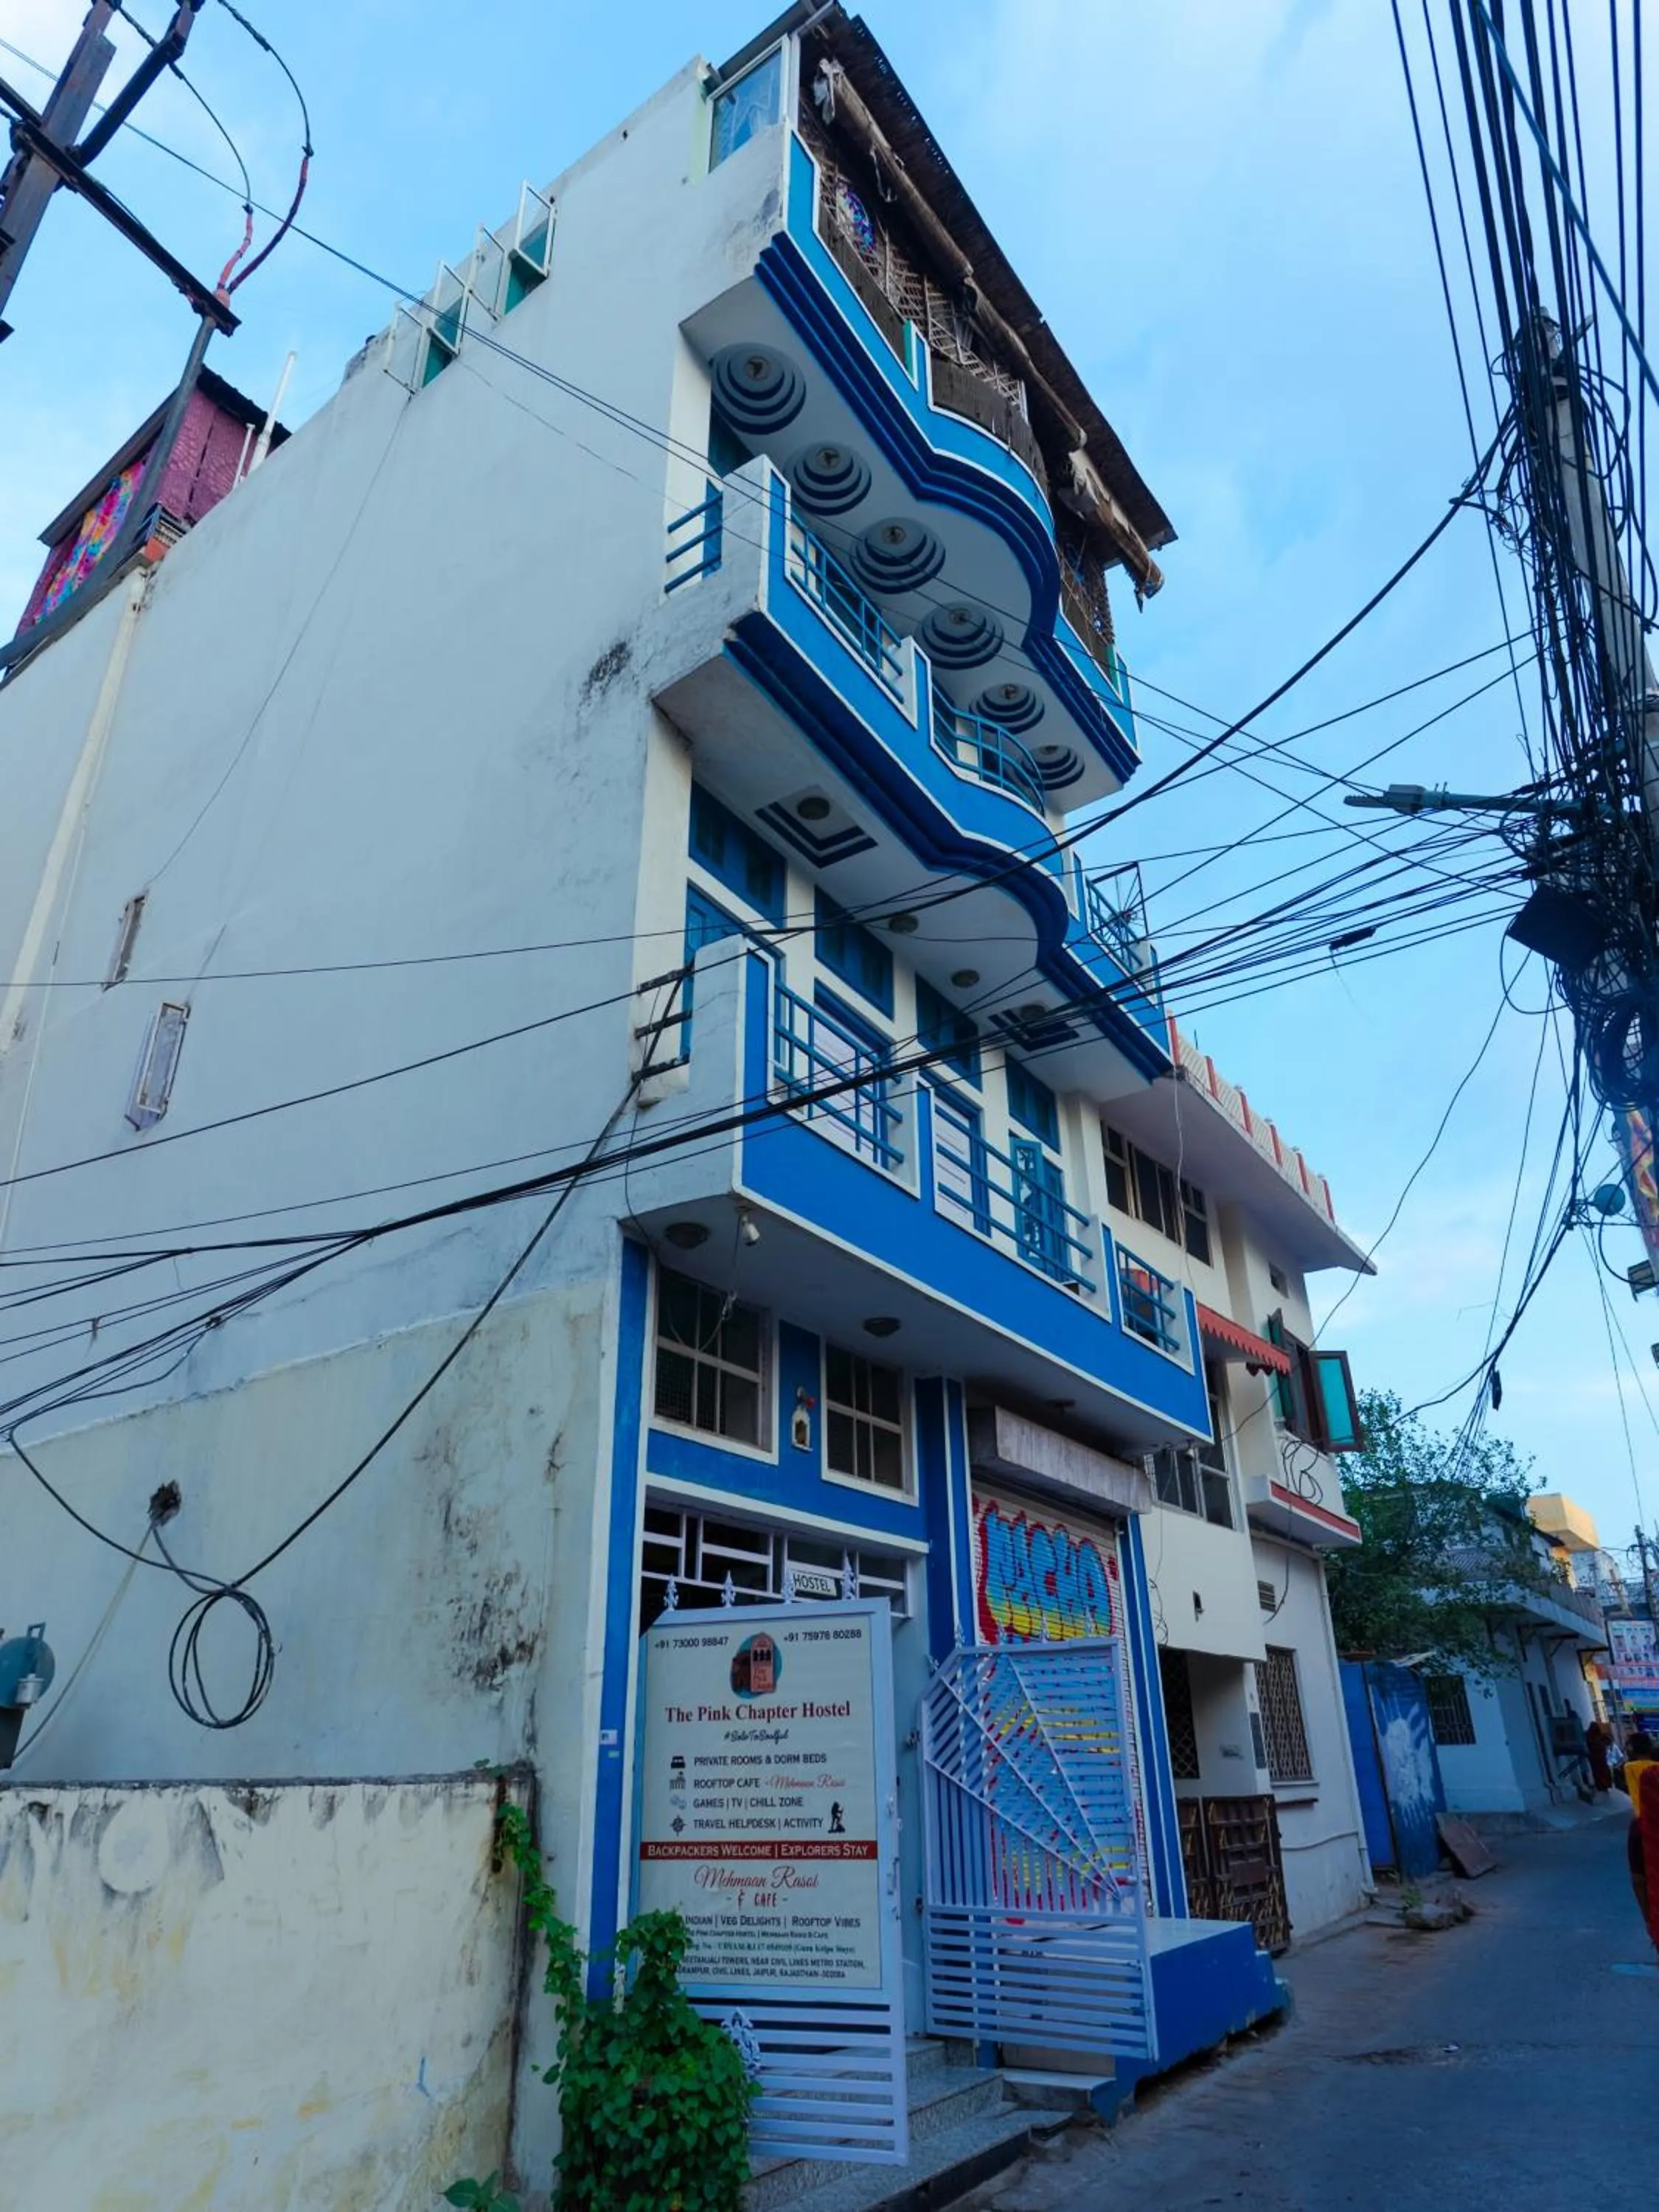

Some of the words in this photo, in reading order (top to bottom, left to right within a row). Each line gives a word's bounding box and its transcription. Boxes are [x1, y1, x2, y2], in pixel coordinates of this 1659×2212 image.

[793, 1573, 831, 1592] HOSTEL
[783, 1632, 799, 1641] +91
[665, 1706, 693, 1722] The
[697, 1704, 731, 1722] Pink
[735, 1703, 798, 1723] Chapter
[802, 1700, 851, 1719] Hostel
[694, 1756, 727, 1767] PRIVATE
[730, 1755, 762, 1766] ROOMS
[765, 1755, 772, 1765] &
[773, 1753, 800, 1765] DORM
[802, 1753, 827, 1764] BEDS
[693, 1778, 735, 1789] ROOFTOP
[737, 1777, 761, 1788] CAFE
[692, 1798, 724, 1808] GAMES
[731, 1797, 743, 1808] TV
[750, 1797, 776, 1807] CHILL
[779, 1796, 804, 1807] ZONE
[692, 1819, 726, 1829] TRAVEL
[728, 1818, 776, 1829] HELPDESK
[783, 1818, 824, 1829] ACTIVITY
[647, 1845, 720, 1857] BACKPACKERS
[720, 1845, 772, 1857] WELCOME
[781, 1845, 842, 1857] EXPLORERS
[843, 1845, 868, 1857] STAY
[754, 1892, 777, 1907] CAFE
[720, 1915, 738, 1926] VEG
[740, 1914, 781, 1927] DELIGHTS
[791, 1916, 832, 1927] ROOFTOP
[834, 1916, 861, 1928] VIBES
